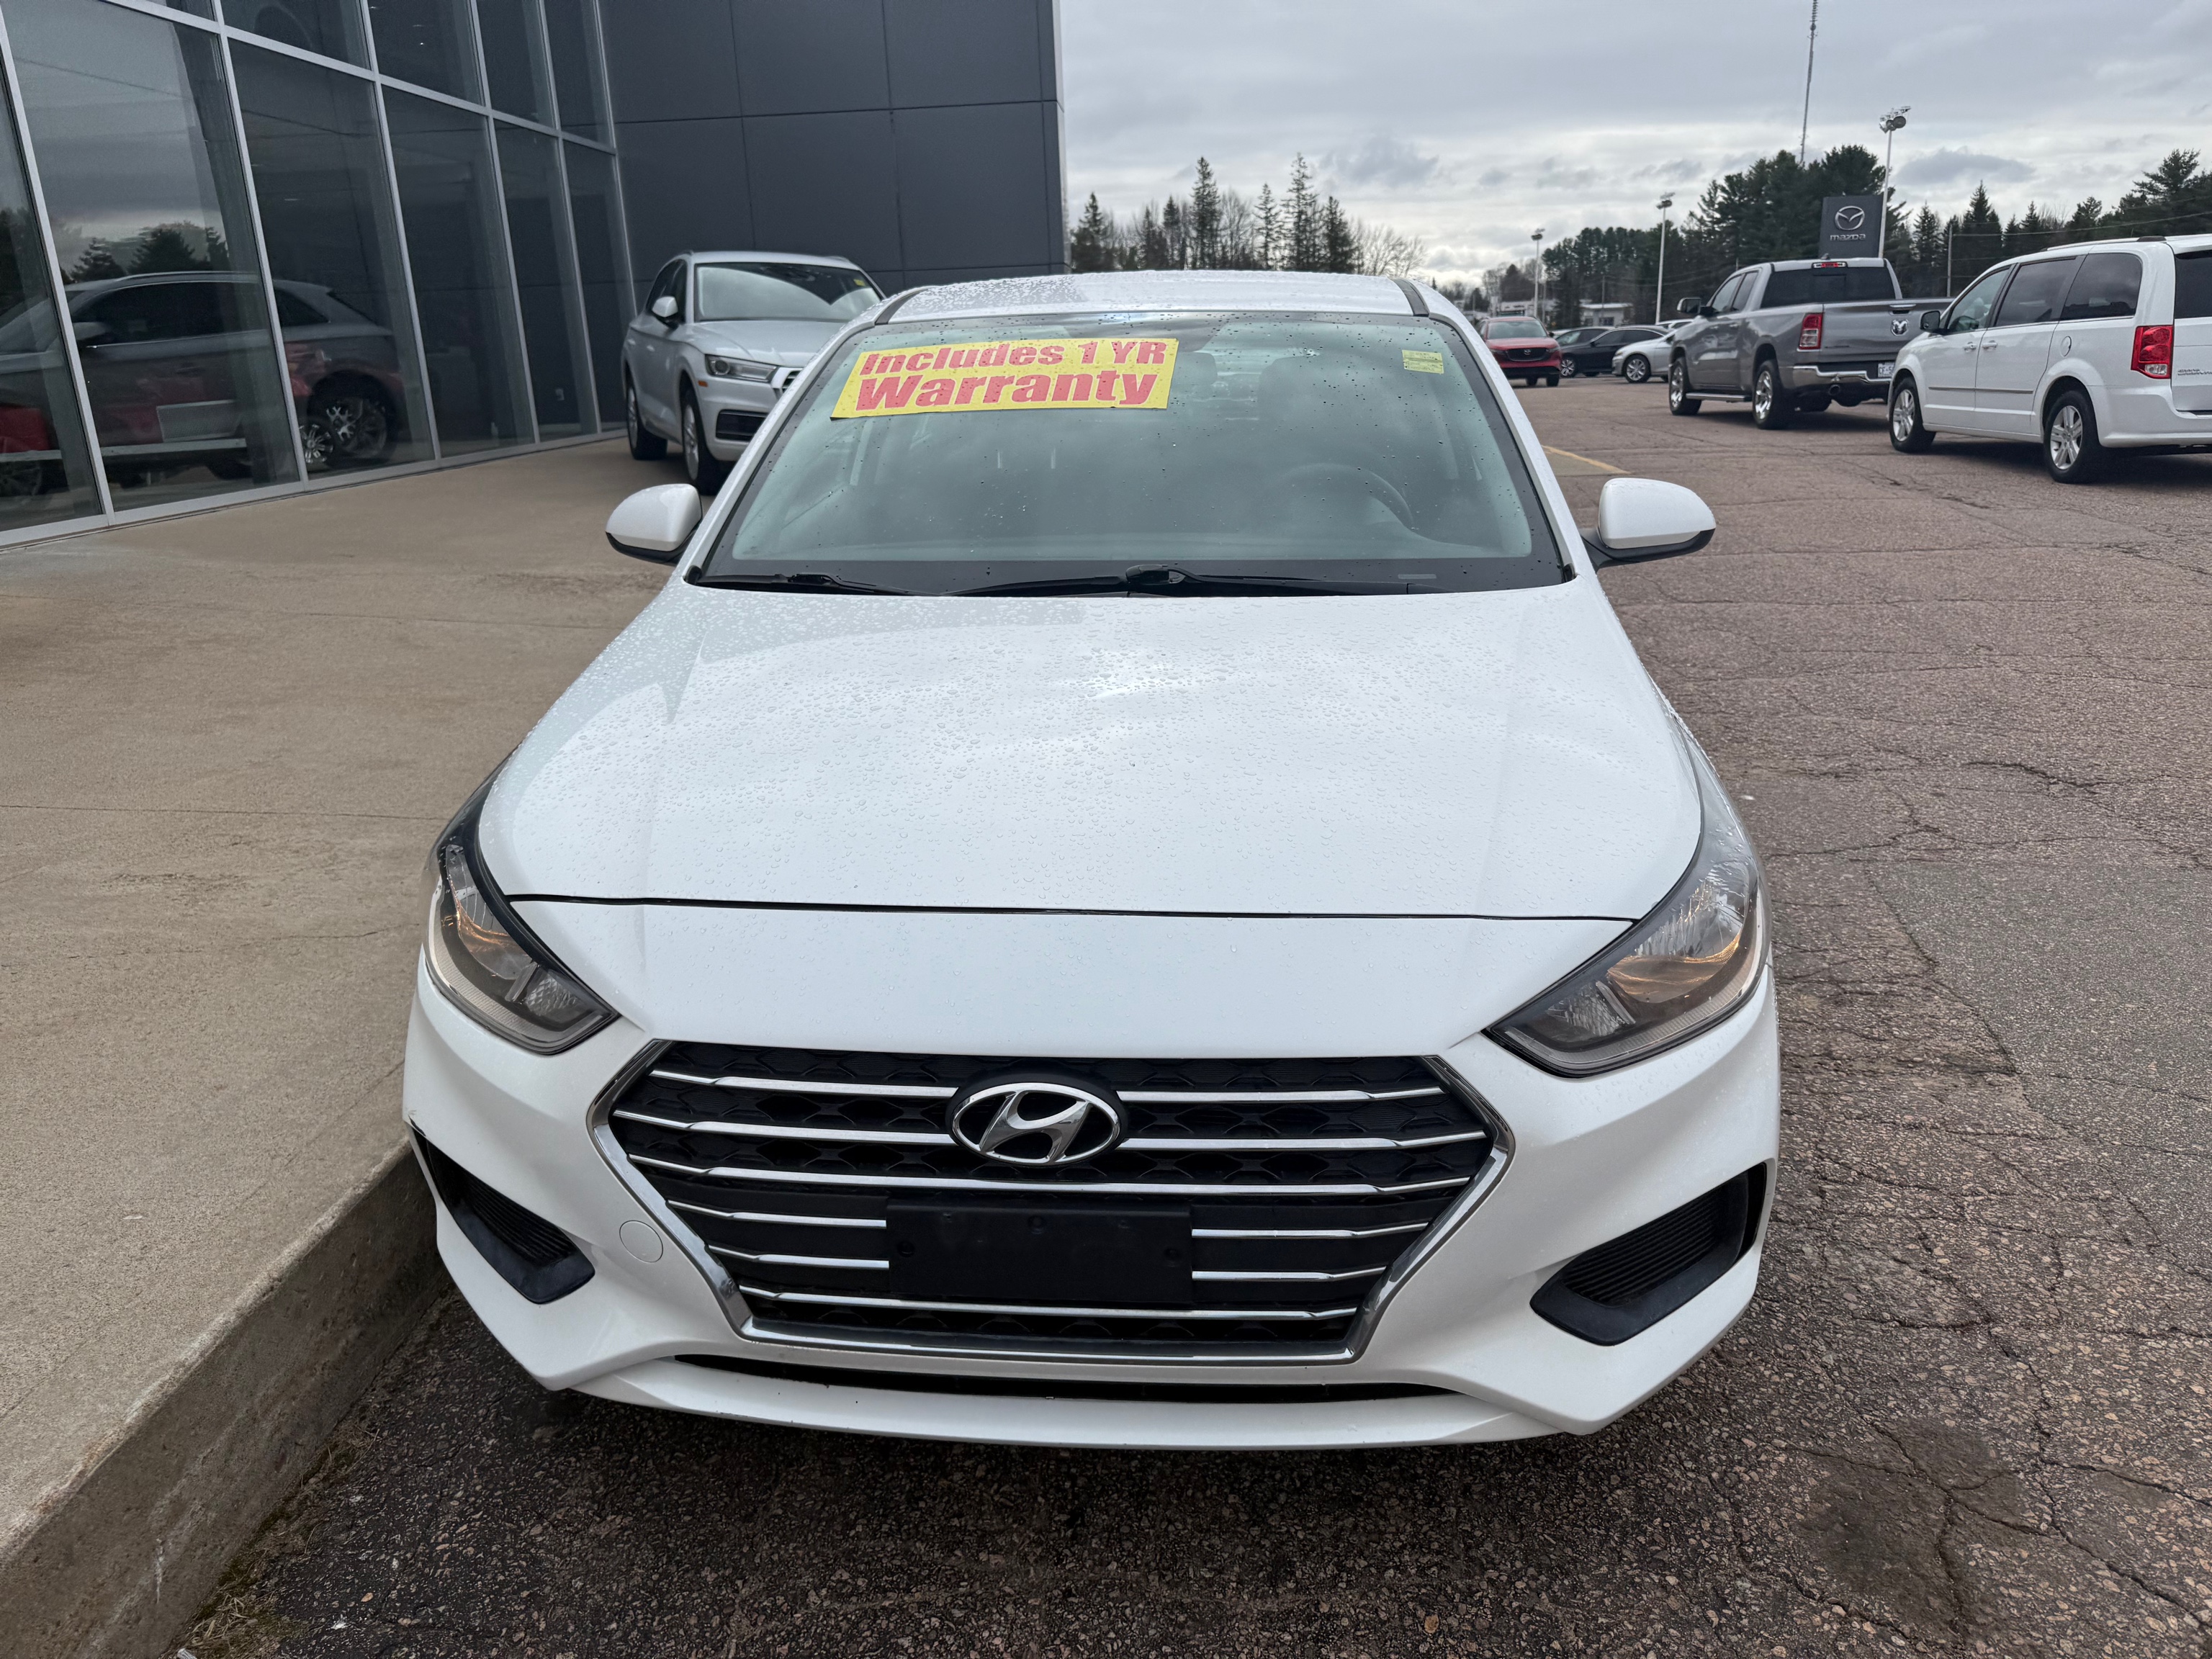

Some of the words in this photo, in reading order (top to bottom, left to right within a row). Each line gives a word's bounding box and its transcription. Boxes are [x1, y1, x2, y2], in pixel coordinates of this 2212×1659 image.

[860, 342, 1064, 375] Includes
[1078, 341, 1099, 364] 1
[1110, 341, 1167, 364] YR
[855, 369, 1158, 411] Warranty
